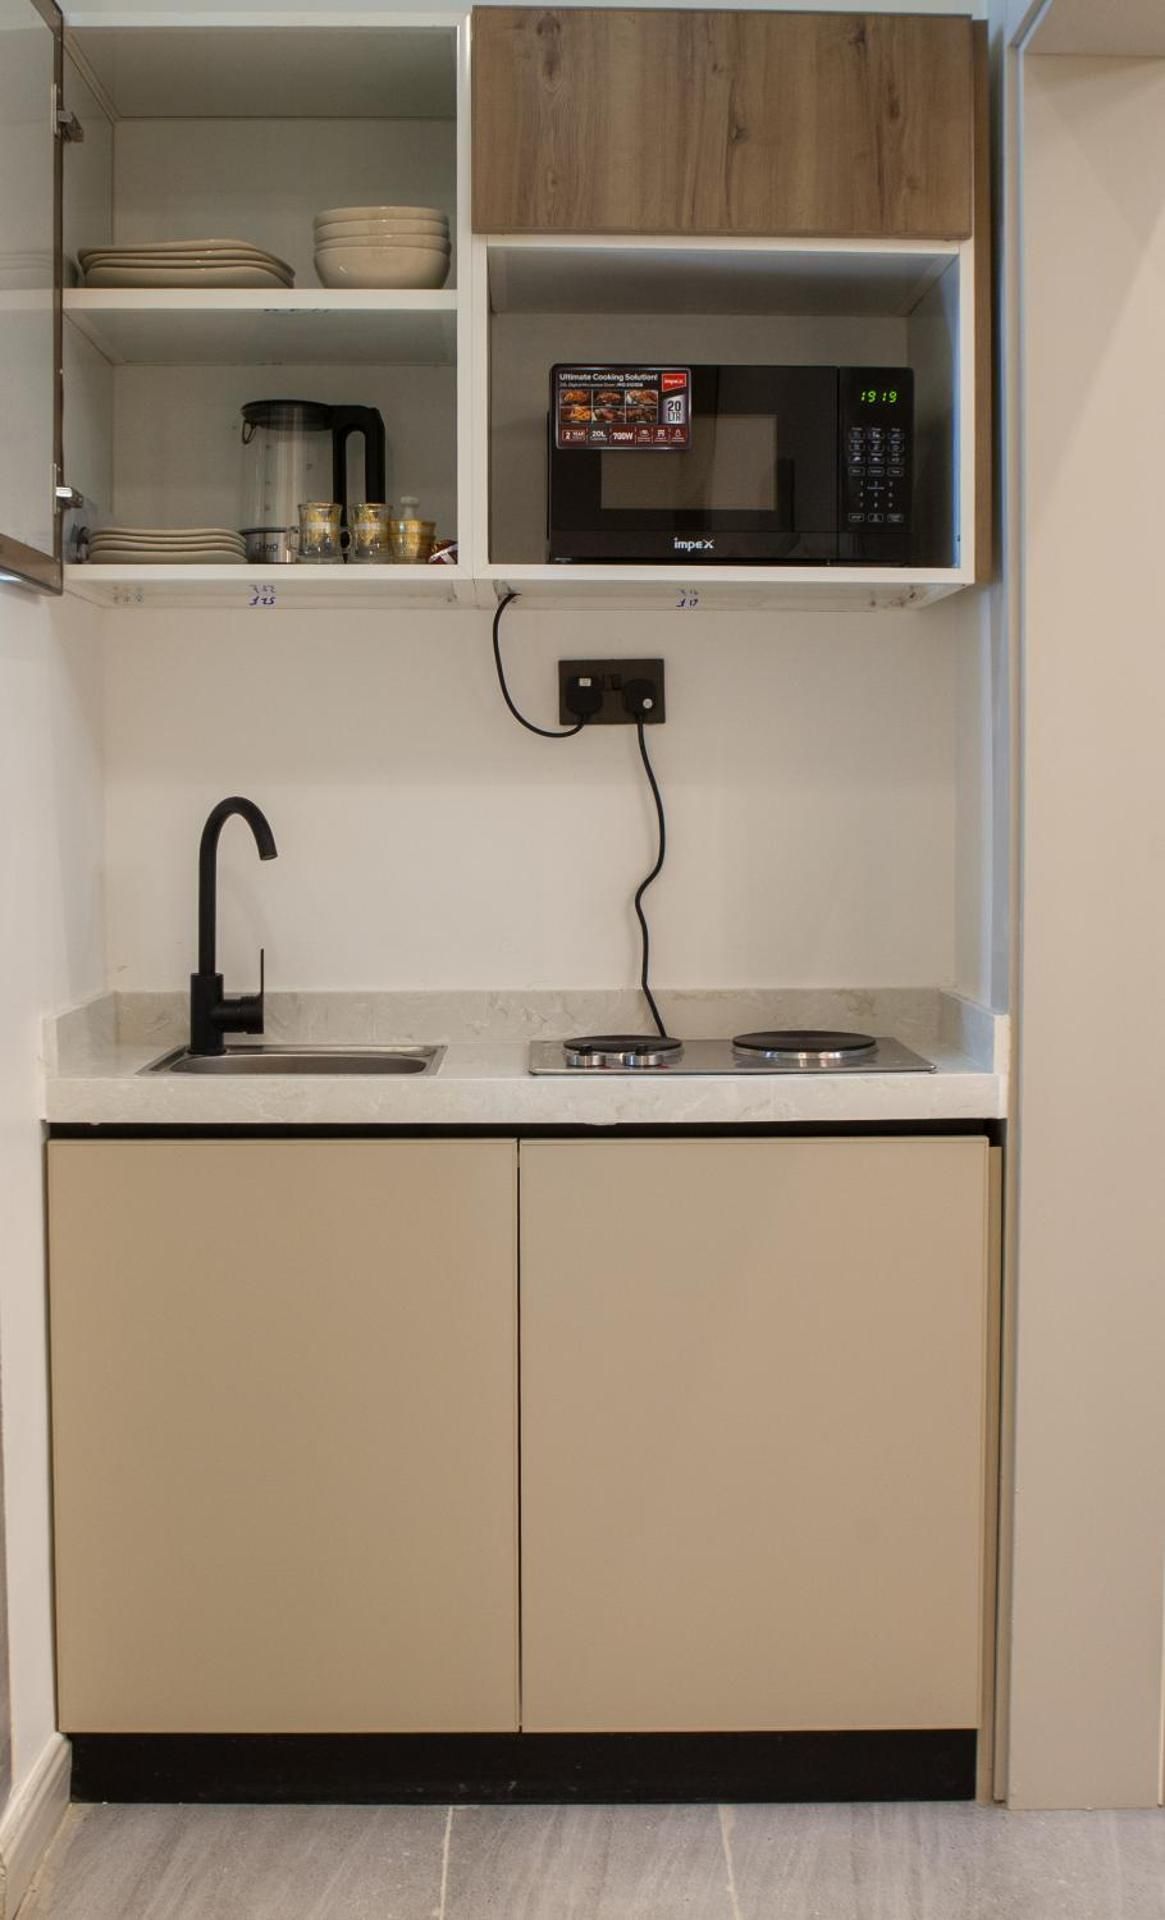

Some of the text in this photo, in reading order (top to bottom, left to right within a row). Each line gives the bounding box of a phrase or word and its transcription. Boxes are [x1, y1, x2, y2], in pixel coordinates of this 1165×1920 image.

[559, 373, 658, 382] Ultimate Cooking Solution!
[667, 400, 682, 412] 20
[667, 411, 681, 422] LTR
[565, 432, 571, 440] 2
